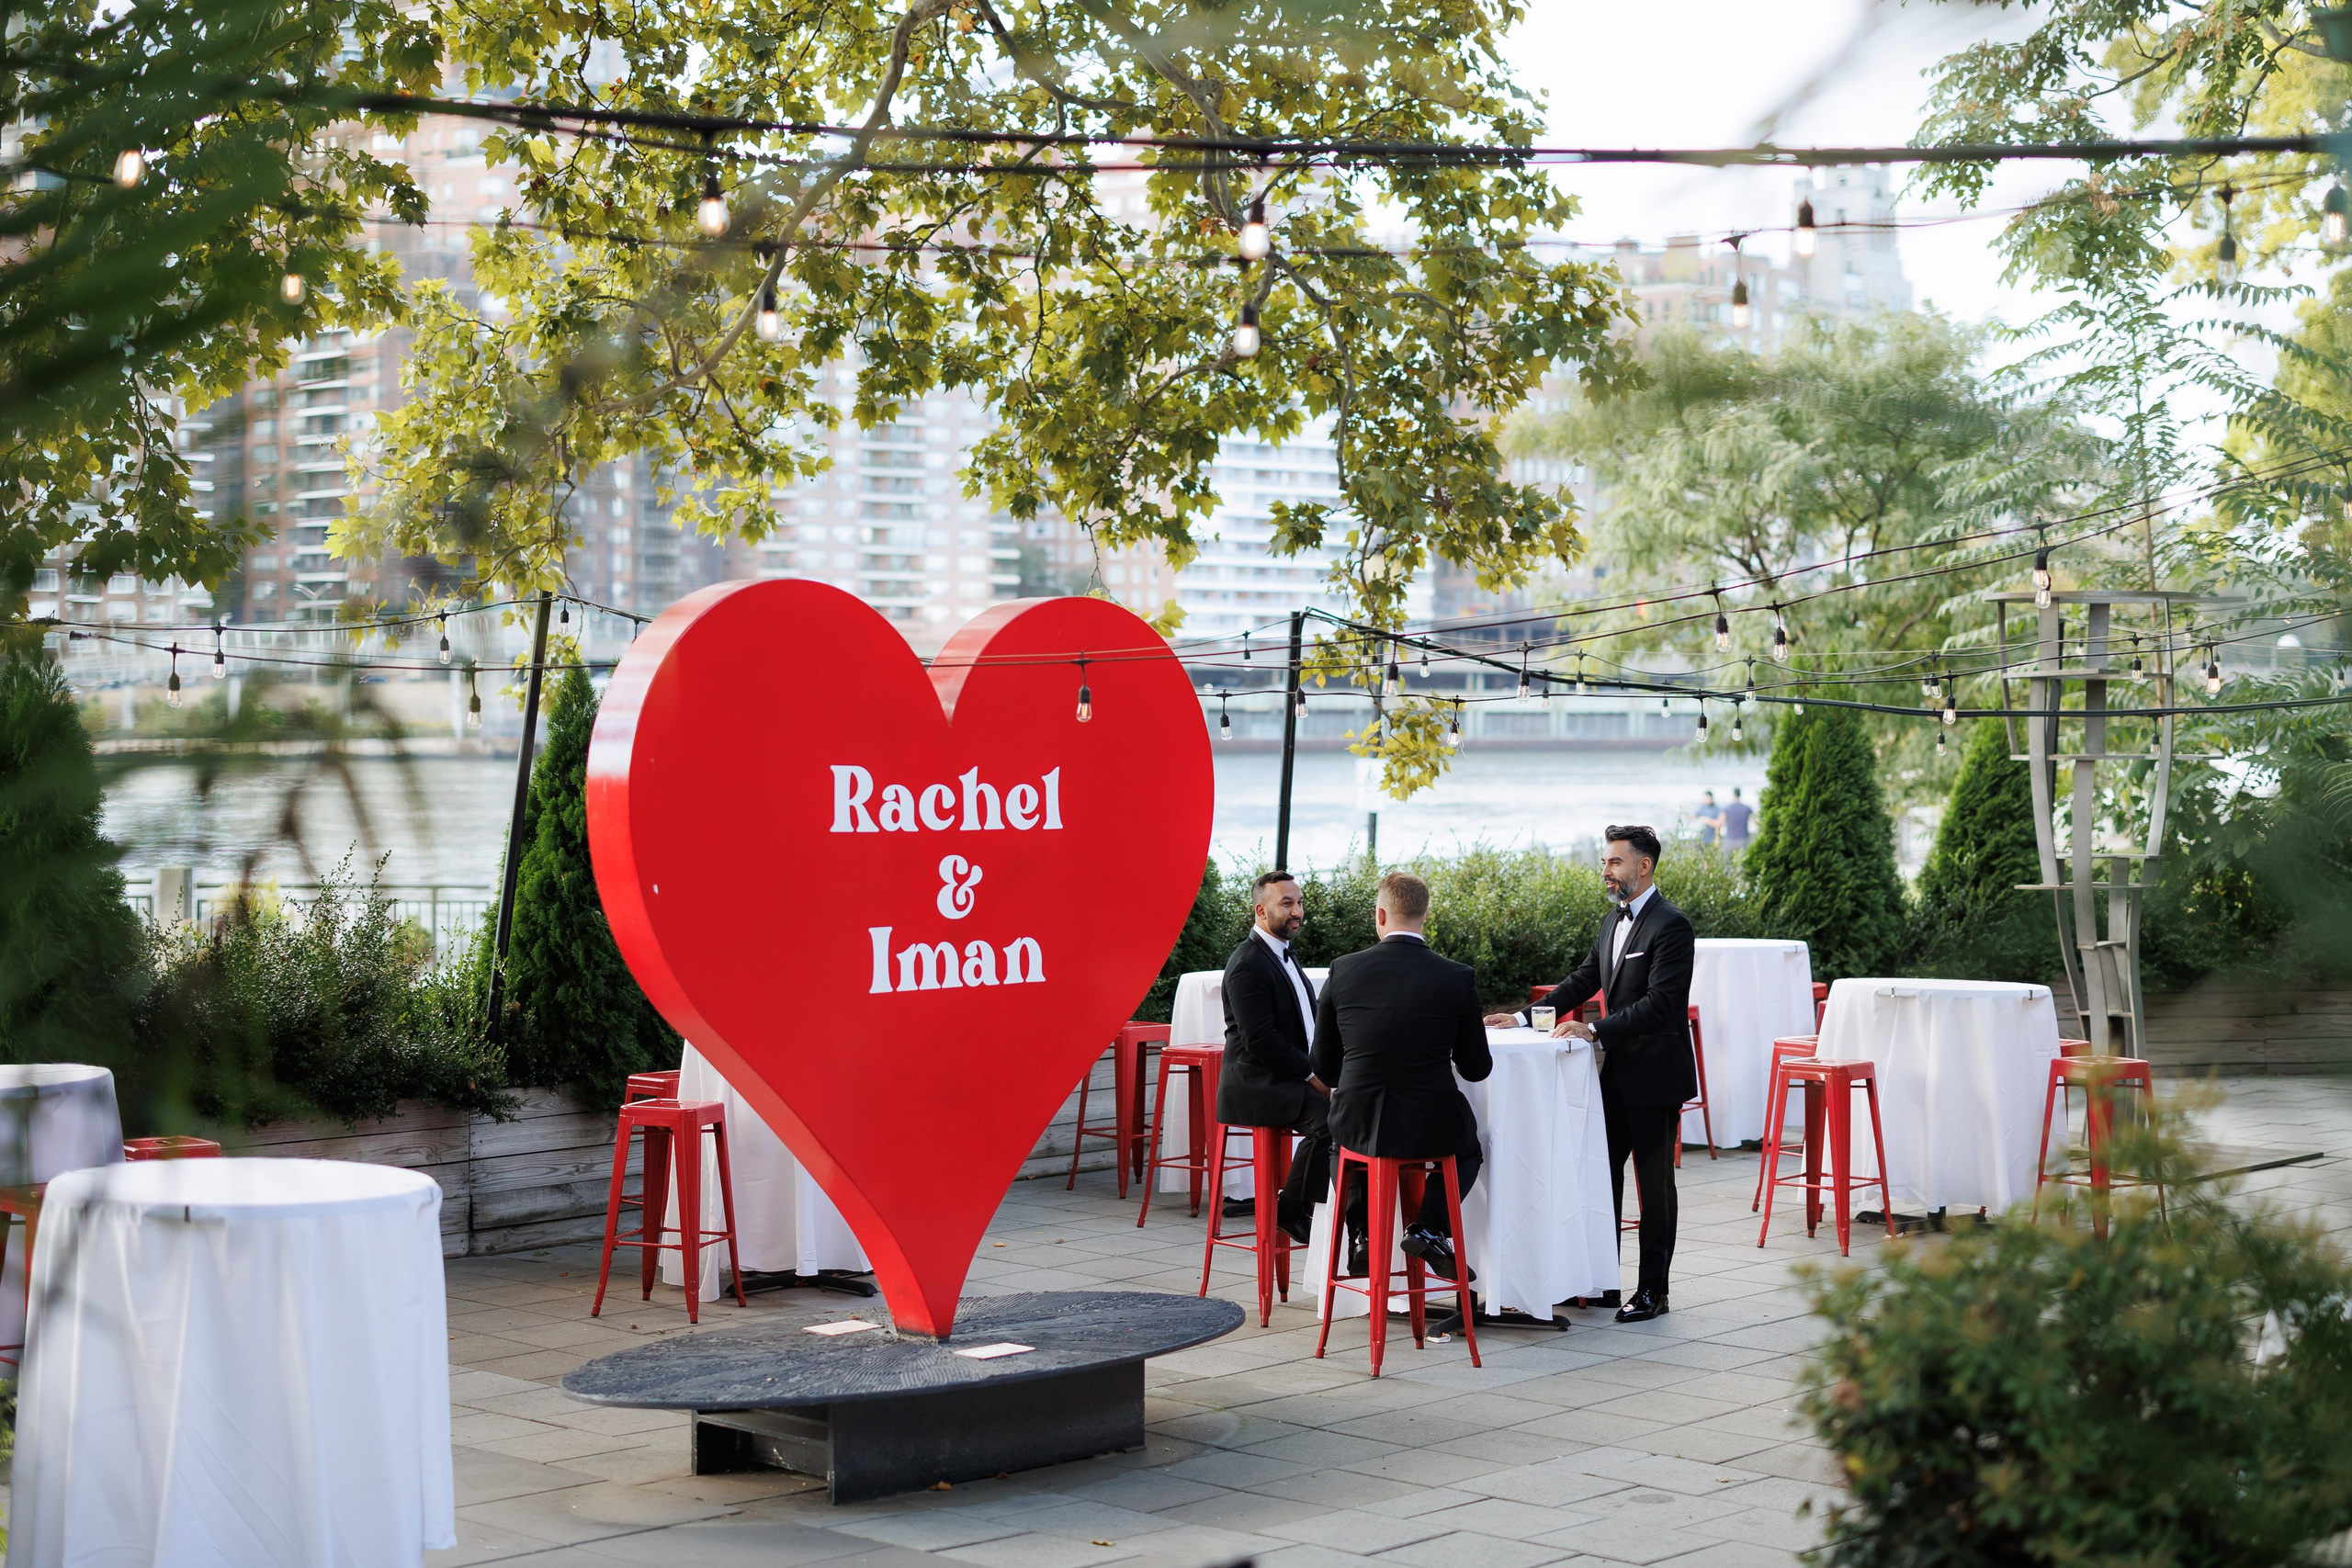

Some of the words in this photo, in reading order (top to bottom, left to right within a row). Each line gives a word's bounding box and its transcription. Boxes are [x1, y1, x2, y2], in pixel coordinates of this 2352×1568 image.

[830, 764, 1064, 833] Rachel
[936, 854, 983, 919] &
[868, 926, 1046, 994] Iman
